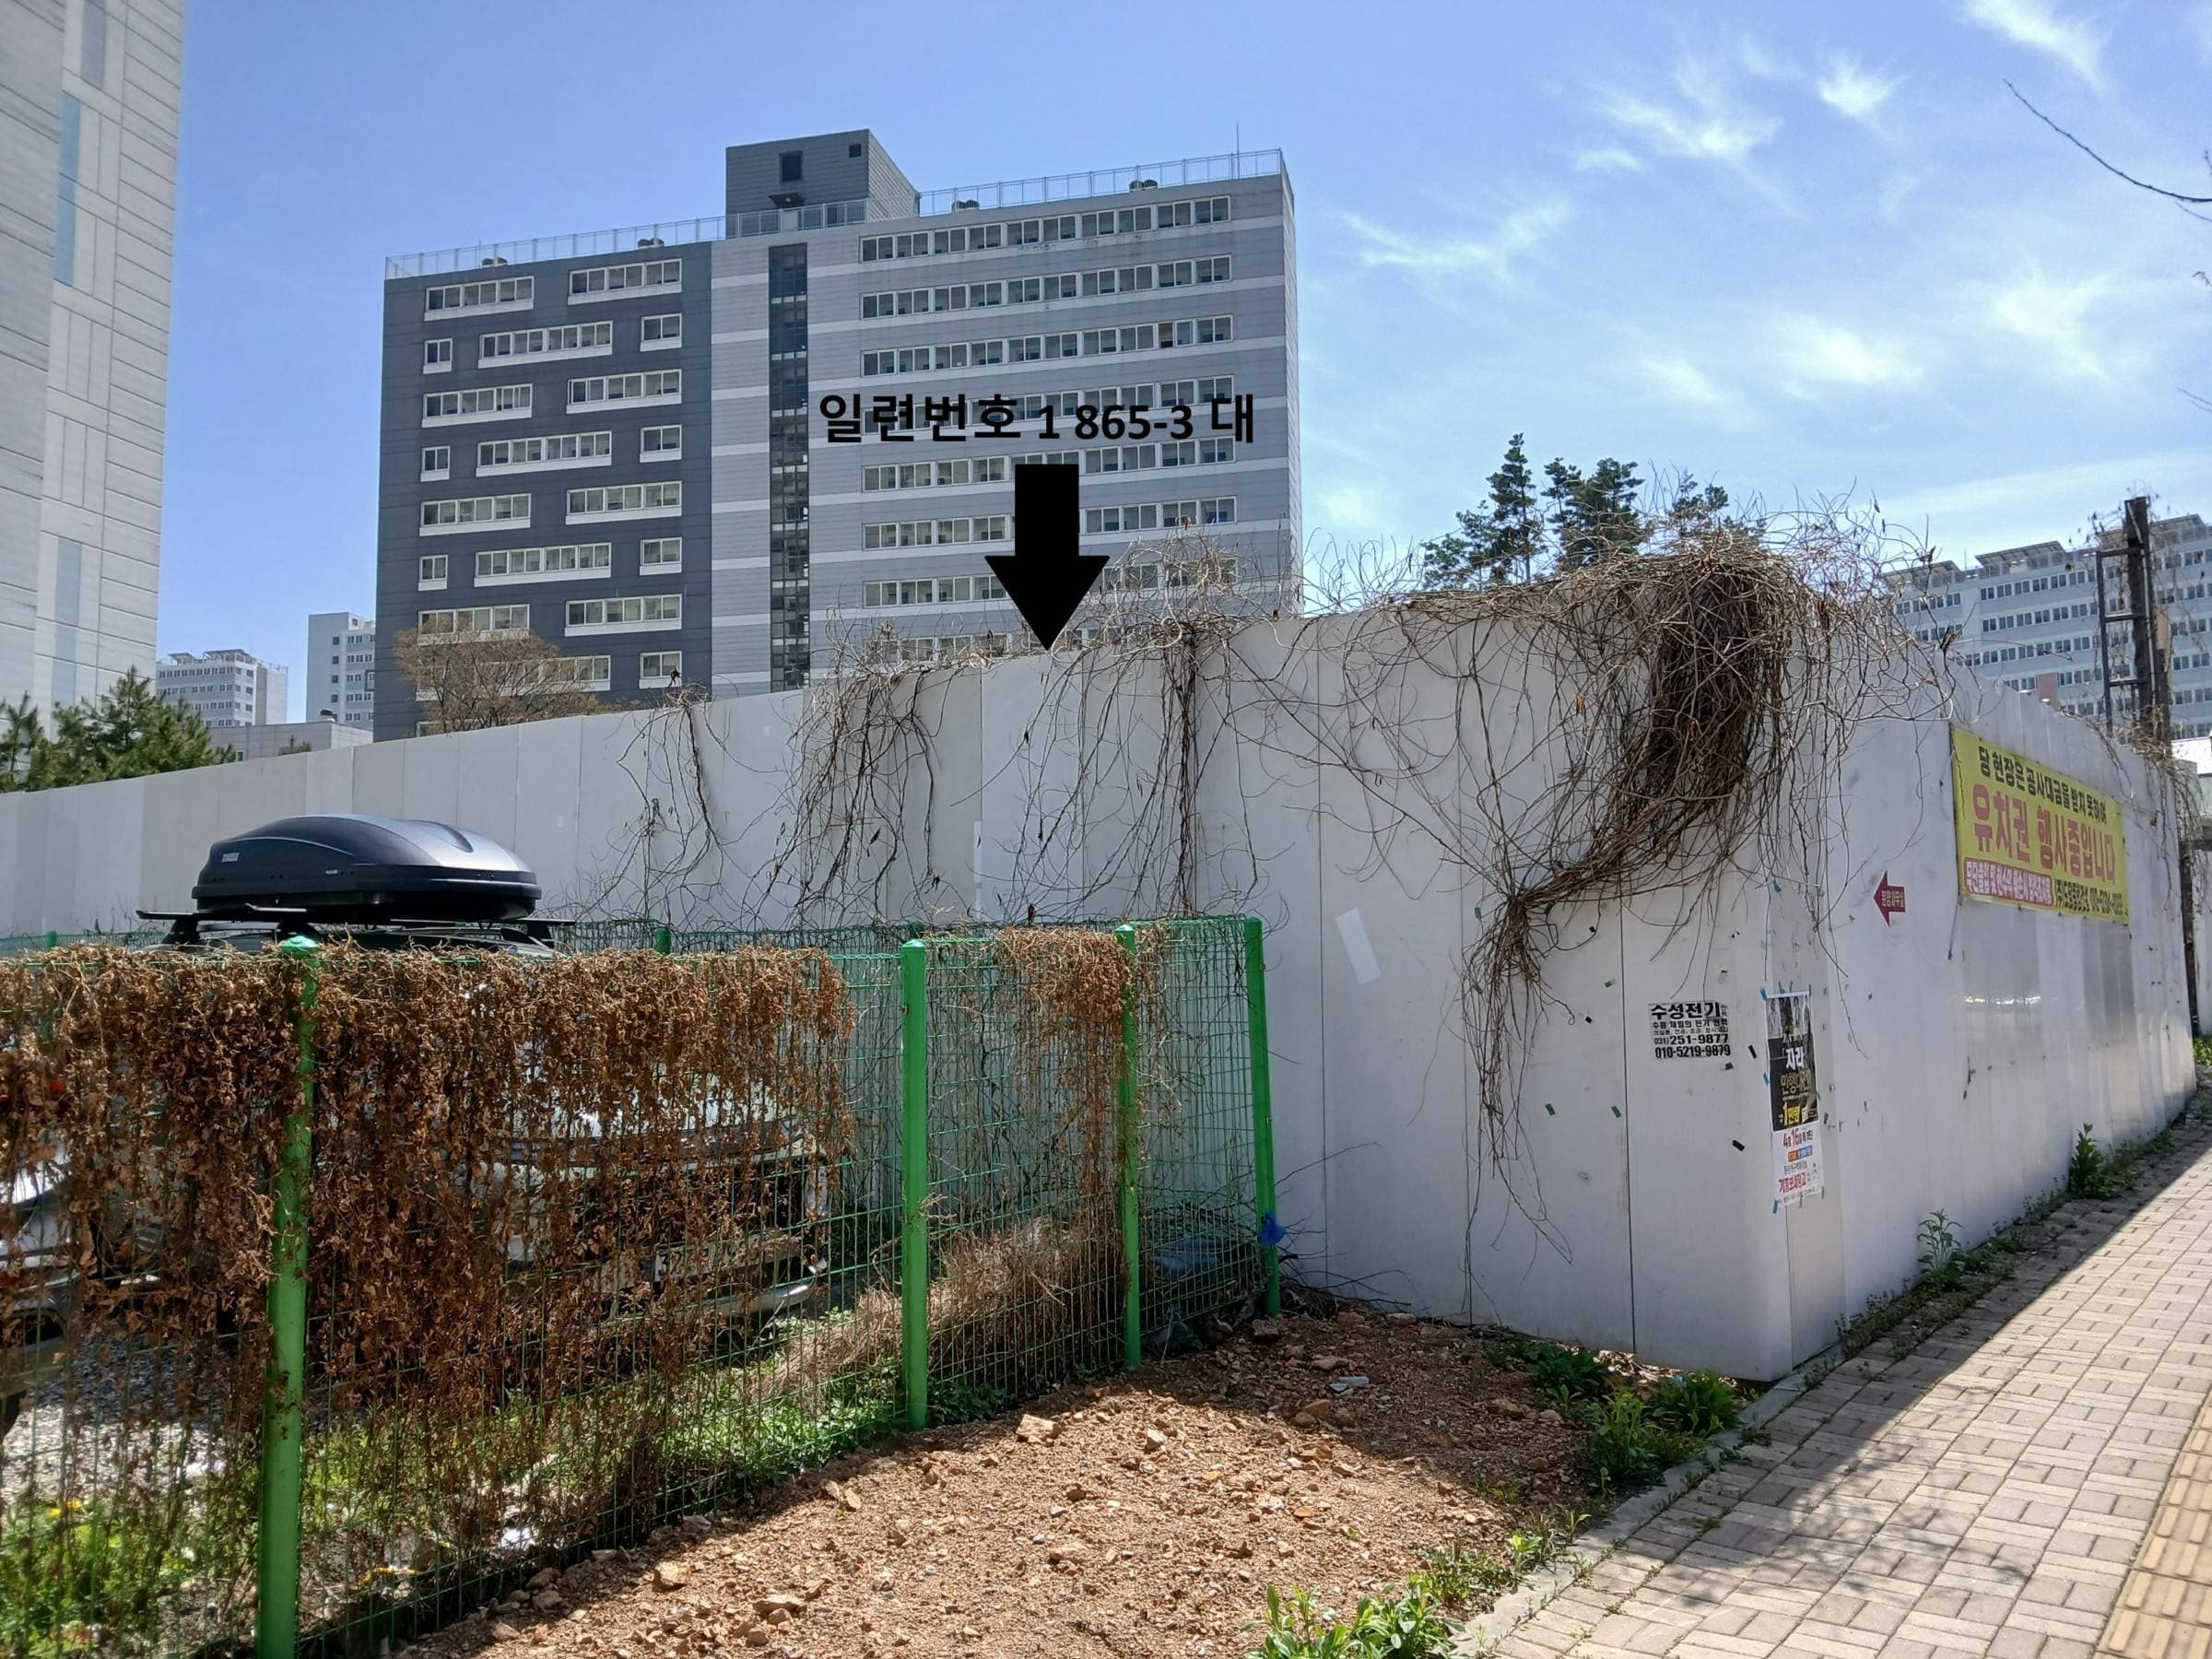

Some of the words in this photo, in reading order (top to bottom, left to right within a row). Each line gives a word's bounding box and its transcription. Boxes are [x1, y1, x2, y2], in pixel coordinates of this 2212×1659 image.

[1978, 746, 1991, 778] 당
[1992, 751, 2026, 792] 현장은
[2026, 767, 2071, 811] 공사대금을
[2071, 785, 2087, 818] 받지
[1972, 783, 2030, 864] 유치권
[2036, 805, 2116, 886] 행사중입니다
[1881, 890, 1904, 908] 분양사무실
[1651, 1002, 1721, 1020] 수성전기
[1655, 1044, 1731, 1058] 010-5219-9879
